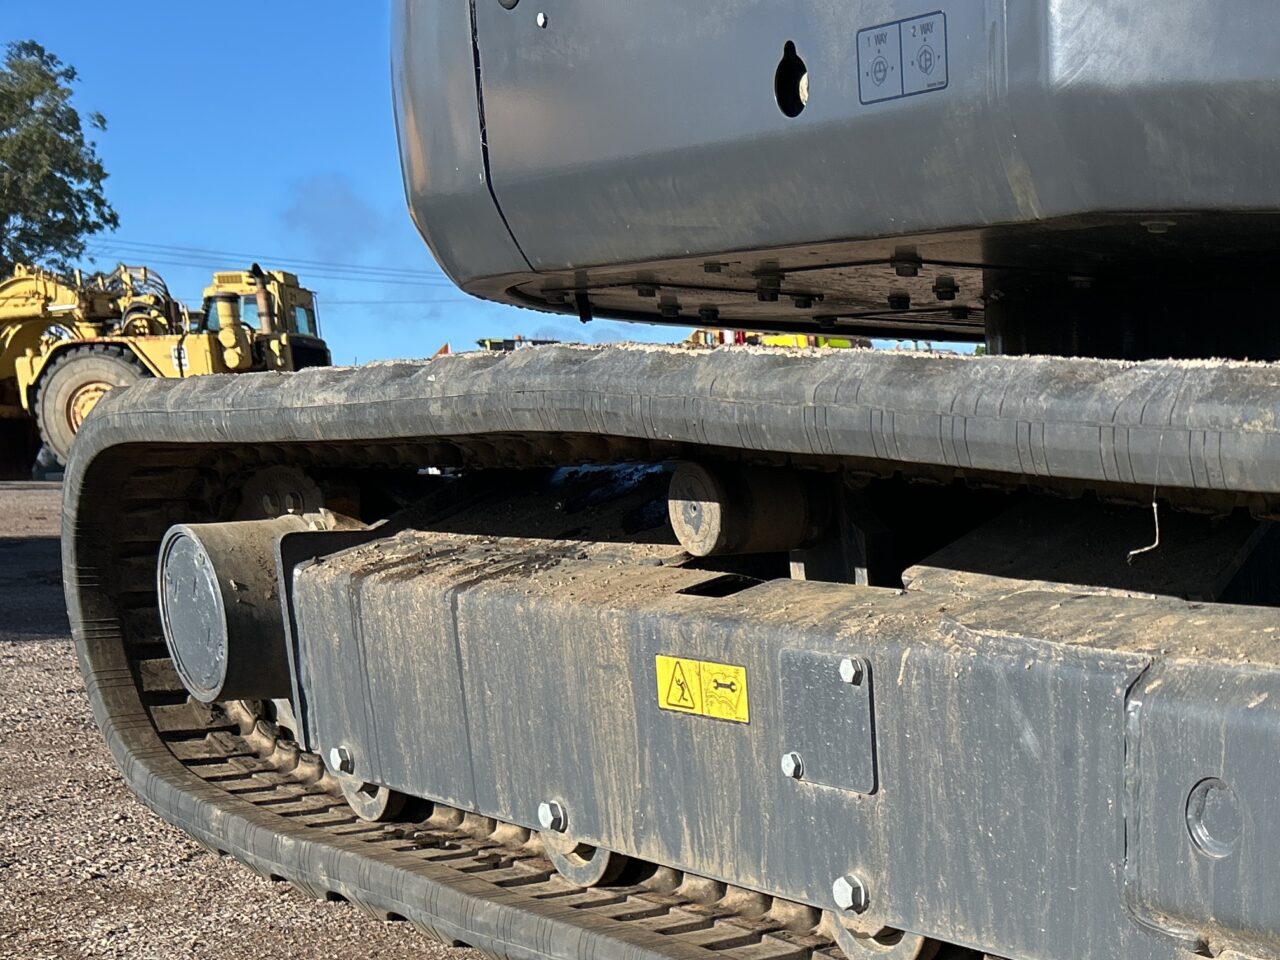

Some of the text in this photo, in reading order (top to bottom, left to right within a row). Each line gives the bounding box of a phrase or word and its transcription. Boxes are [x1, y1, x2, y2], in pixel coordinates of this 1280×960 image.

[911, 21, 934, 37] 2 WAY
[874, 31, 888, 46] WAY
